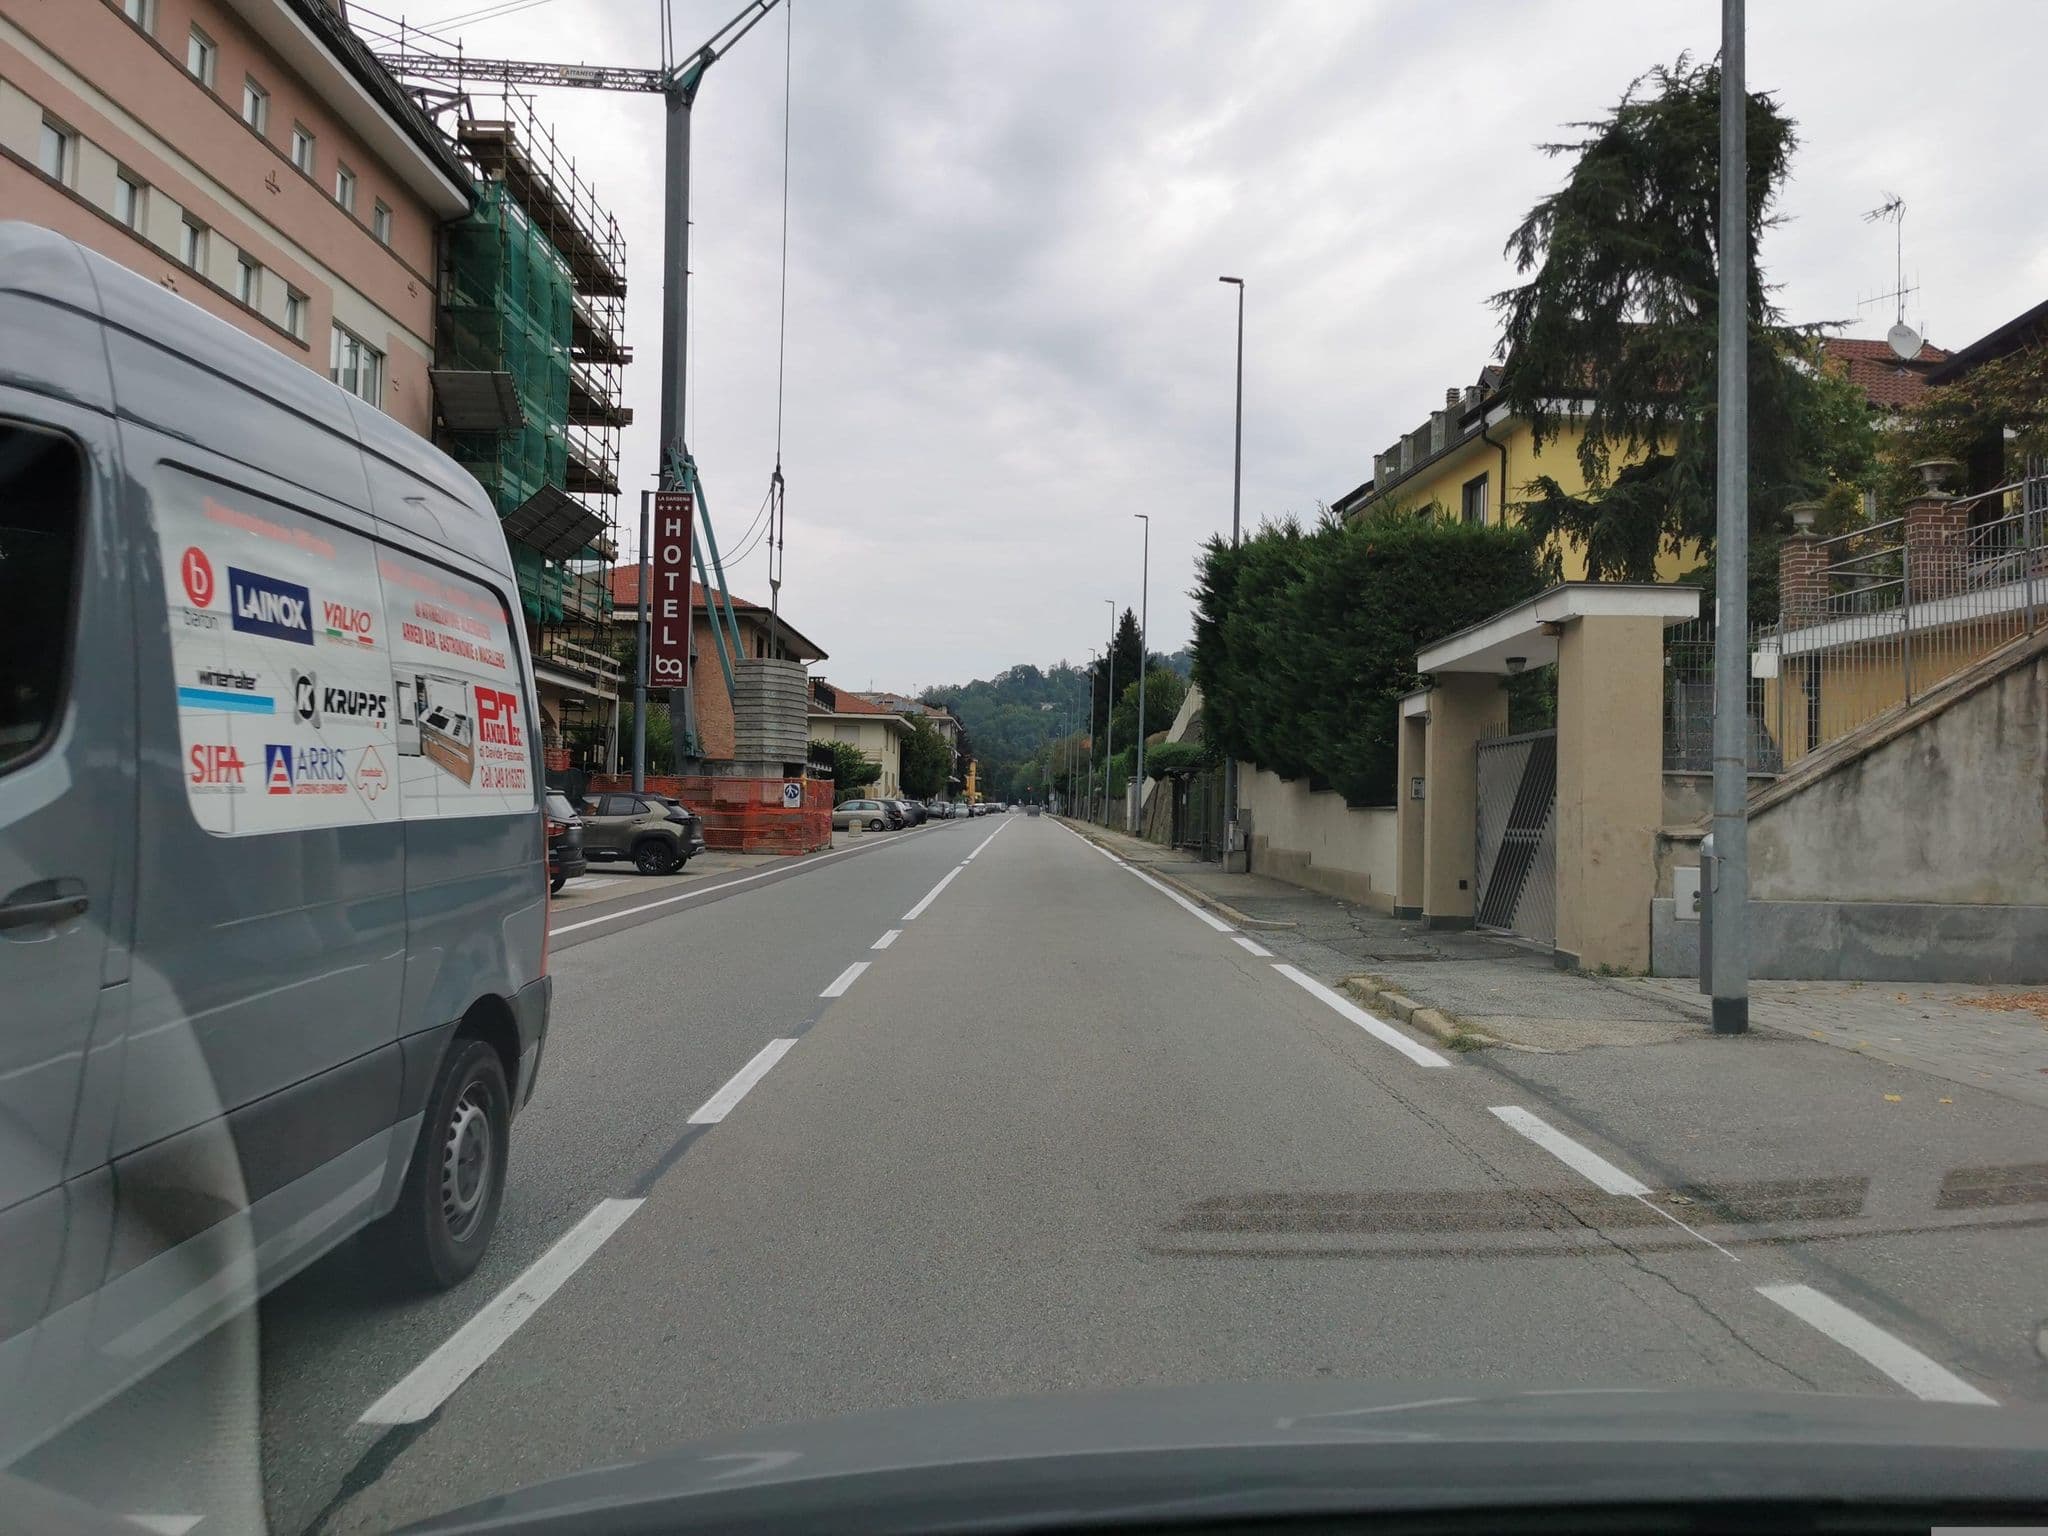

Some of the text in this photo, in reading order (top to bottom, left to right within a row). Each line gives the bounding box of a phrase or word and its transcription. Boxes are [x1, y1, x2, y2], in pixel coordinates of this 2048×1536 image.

[663, 518, 682, 645] HOTEL
[236, 584, 308, 631] LAINOX
[323, 601, 372, 633] VALKO
[324, 687, 387, 718] KRUPPS
[191, 744, 245, 784] SIFA
[296, 747, 346, 780] ARRIS
